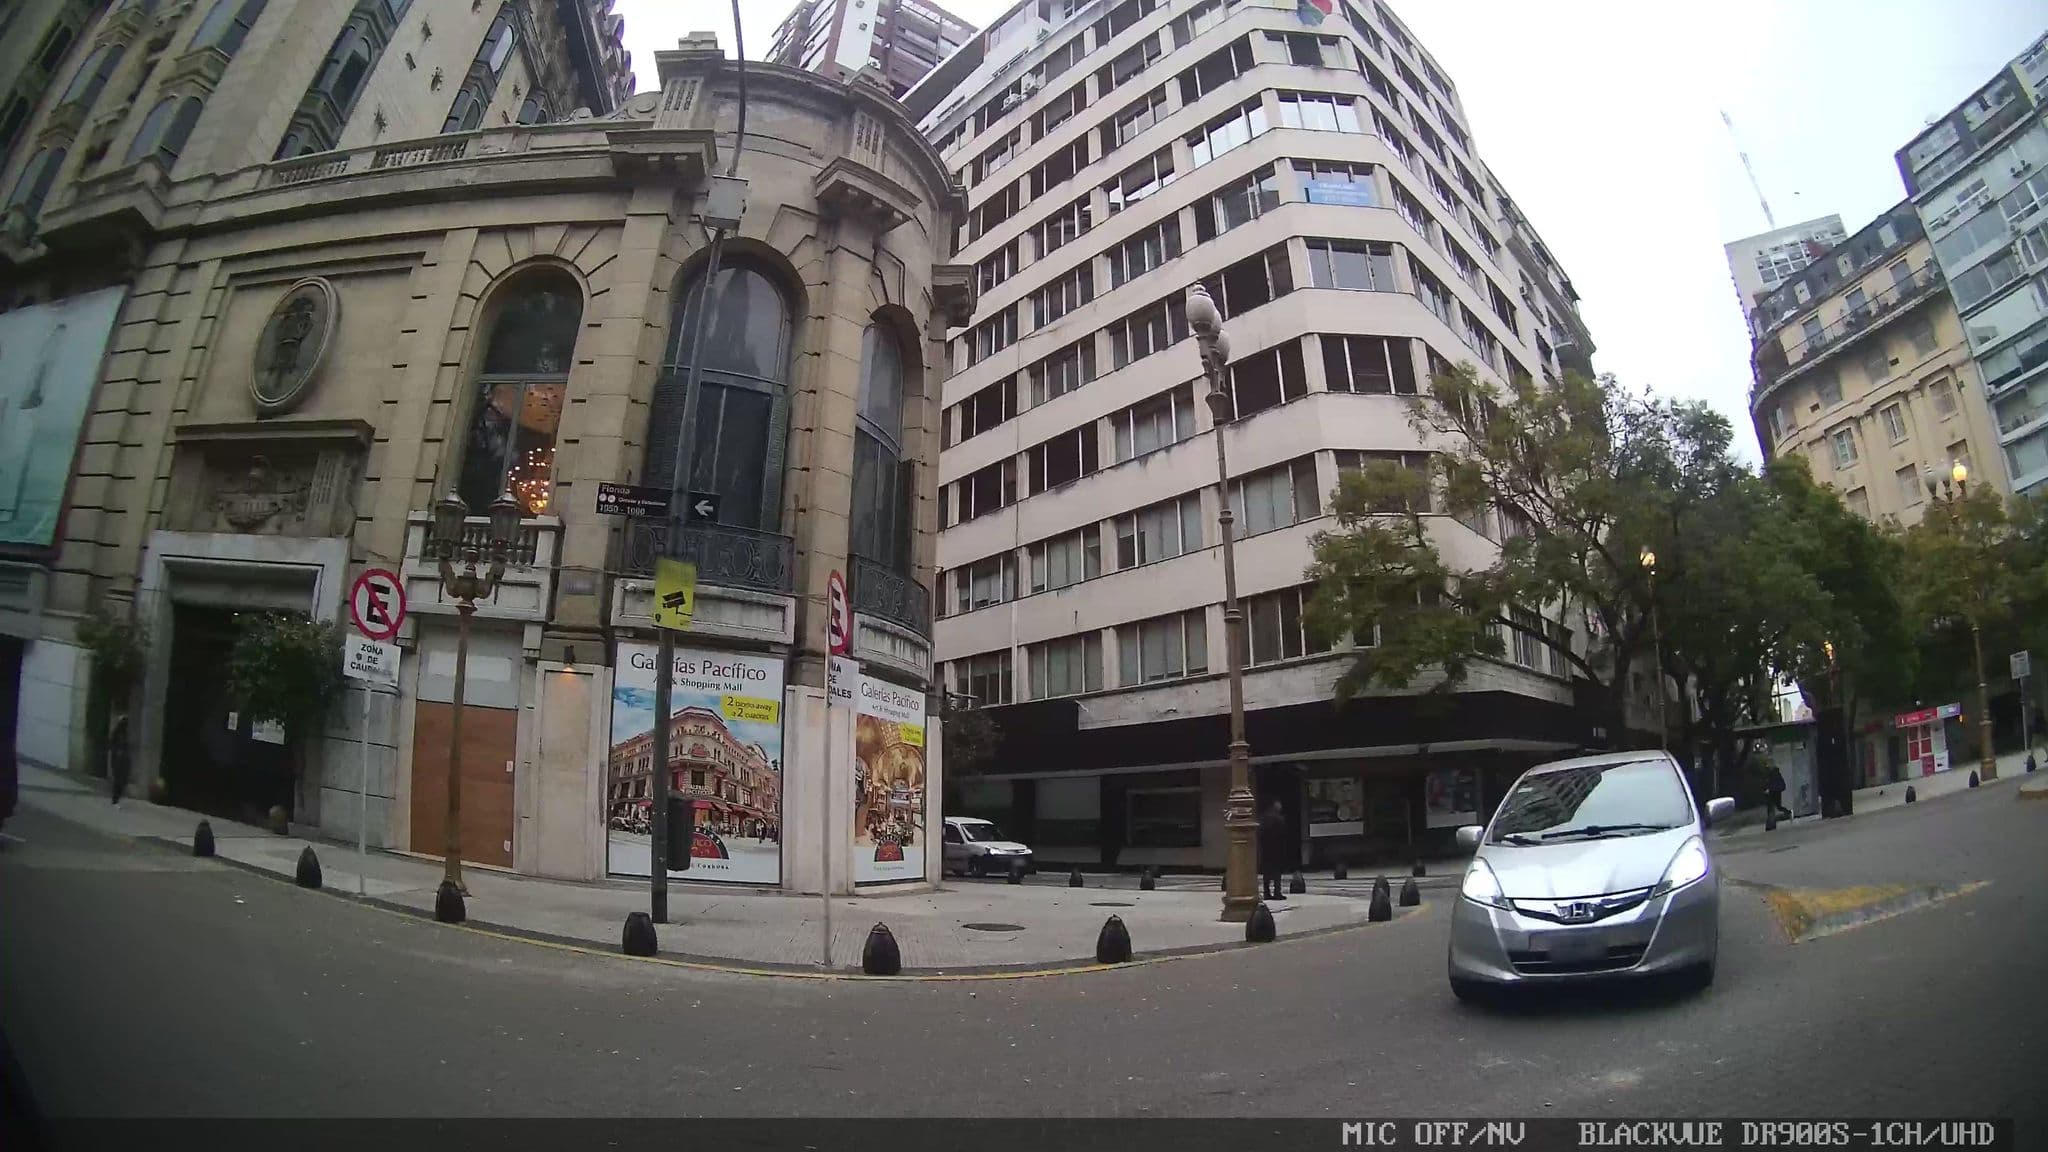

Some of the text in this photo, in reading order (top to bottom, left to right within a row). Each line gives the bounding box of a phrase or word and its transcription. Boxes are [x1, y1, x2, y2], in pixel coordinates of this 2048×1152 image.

[361, 643, 383, 656] ZONA
[367, 655, 379, 665] DE
[631, 652, 767, 681] Galías Pacífico
[350, 661, 388, 675] CAUDA
[680, 678, 721, 692] Shopping
[723, 682, 743, 692] Mall
[828, 685, 852, 699] DALES
[727, 696, 734, 706] 2
[737, 708, 743, 717] 2
